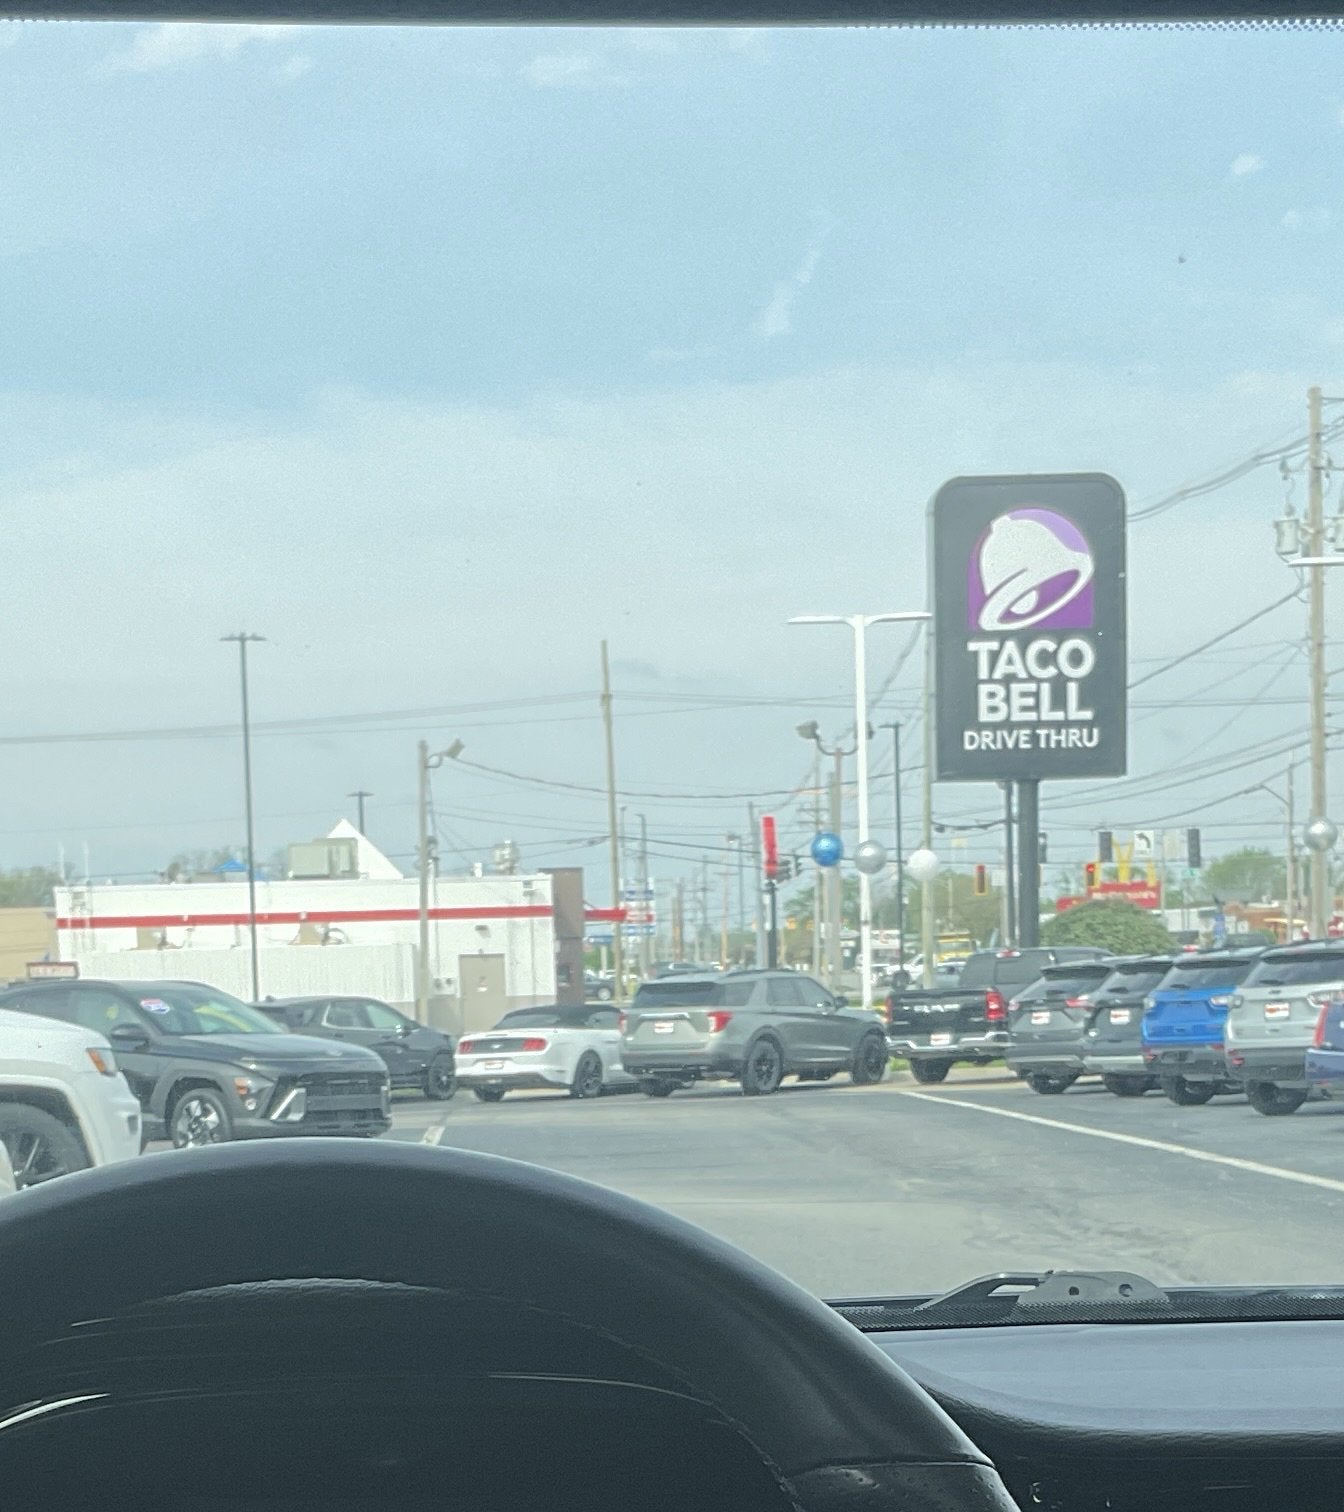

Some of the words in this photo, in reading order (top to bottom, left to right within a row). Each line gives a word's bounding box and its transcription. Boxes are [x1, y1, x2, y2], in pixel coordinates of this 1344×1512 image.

[966, 638, 1095, 680] TACO
[977, 681, 1094, 723] BELL
[963, 729, 1032, 750] DRIVE
[1036, 728, 1099, 748] THRU
